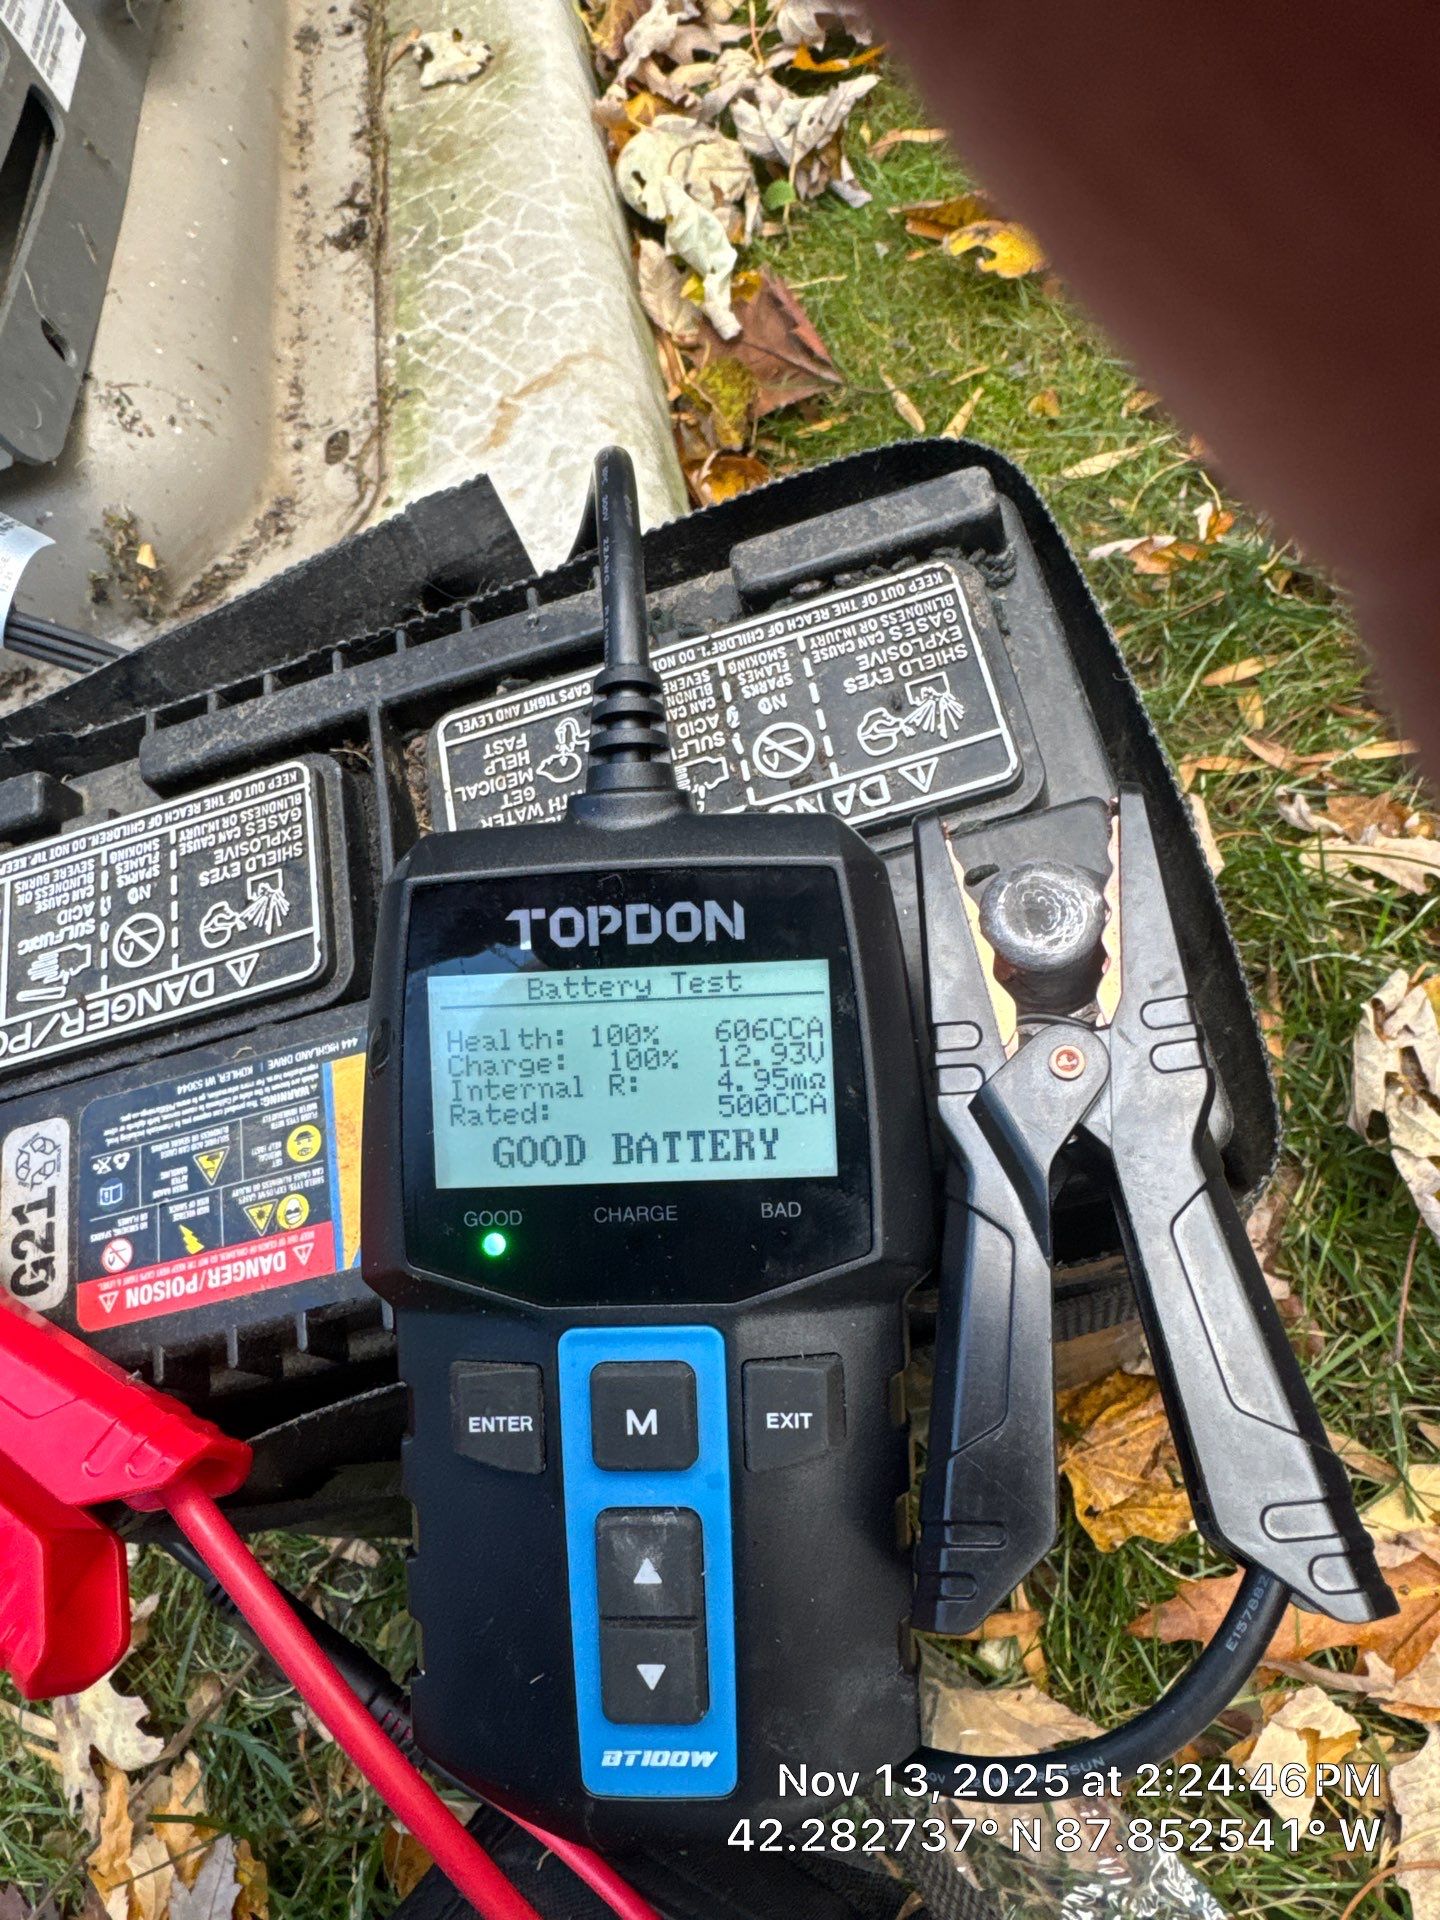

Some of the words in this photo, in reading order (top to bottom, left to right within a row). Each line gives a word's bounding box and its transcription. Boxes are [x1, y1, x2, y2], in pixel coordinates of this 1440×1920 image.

[877, 582, 906, 602] OUT
[906, 570, 944, 593] KEEP
[831, 597, 859, 617] THE
[858, 591, 879, 609] OF
[878, 592, 955, 628] BLINDNESS
[765, 620, 785, 638] OF
[785, 606, 830, 632] REACH
[857, 616, 879, 635] OR
[886, 606, 958, 643] GASES
[806, 623, 857, 650] INJURY
[854, 623, 964, 672] EXPLOSIVE
[855, 629, 886, 650] CAN
[677, 647, 695, 665] DO
[726, 645, 787, 675] SMOKING
[809, 638, 857, 664] CAUSE
[896, 642, 969, 678] SHIELD
[661, 667, 710, 695] SEVERE
[736, 658, 790, 687] FLAMES
[740, 671, 793, 699] SPARKS
[841, 665, 895, 695] EYES
[520, 691, 557, 715] TIGHT
[559, 681, 591, 703] CAPS
[756, 690, 788, 717] NO
[494, 702, 521, 722] AND
[689, 695, 716, 715] CAN
[455, 711, 493, 735] LEVEL
[675, 711, 720, 740] ACID
[480, 731, 527, 759] FAST
[483, 748, 530, 777] HELP
[243, 780, 264, 798] OUT
[267, 769, 296, 790] KEEP
[454, 765, 534, 804] MEDICAL
[204, 793, 224, 811] THE
[226, 787, 241, 804] OF
[239, 792, 302, 823] BLINDNESS
[498, 784, 535, 810] GET
[146, 812, 161, 829] OF
[163, 800, 201, 825] REACH
[221, 812, 237, 829] OR
[244, 805, 301, 837] GASES
[177, 818, 220, 843] INJURY
[217, 824, 240, 844] CAN
[47, 841, 69, 861] NOT
[71, 836, 85, 853] DO
[109, 836, 159, 864] SMOKING
[178, 832, 215, 856] CAUSE
[213, 822, 302, 865] EXPLOSIVE
[244, 839, 302, 873] SHIELD
[51, 856, 94, 882] SEVERE
[115, 849, 159, 876] FLAMES
[198, 859, 241, 887] EYES
[13, 871, 49, 894] BURNS
[34, 869, 94, 901] BLINDNESS
[117, 863, 160, 888] SPARKS
[16, 889, 32, 906] OR
[33, 891, 69, 914] CAUSE
[71, 883, 93, 902] CAN
[128, 882, 151, 906] NO
[57, 899, 94, 926] ACID
[504, 900, 746, 950] TOPDON
[16, 916, 95, 956] SULFURIC
[527, 977, 651, 1002] Battery
[671, 970, 741, 994] Test
[342, 1036, 358, 1050] 444
[446, 1029, 565, 1053] Health:
[591, 1024, 660, 1048] 100%
[714, 1017, 824, 1042] 606CCA
[268, 1053, 294, 1070] DRIVE
[295, 1041, 339, 1063] HIGHLAND
[447, 1054, 567, 1078] Charge:
[609, 1048, 679, 1072] 100%
[718, 1042, 824, 1068] 12.93V
[176, 1077, 203, 1095] 53044
[204, 1074, 215, 1087] WI
[450, 1077, 584, 1102] Internal
[609, 1074, 639, 1097] R:
[450, 1102, 549, 1127] Rated:
[718, 1094, 827, 1118] 500CCA
[493, 1134, 586, 1169] GOOD
[612, 1128, 779, 1165] BATTERY
[463, 1210, 523, 1228] GOOD
[593, 1205, 679, 1224] CHARGE
[760, 1201, 801, 1220] BAD
[10, 1186, 56, 1297] G21
[125, 1248, 286, 1309] DANGER/POISON
[468, 1415, 533, 1434] ENTER
[625, 1409, 658, 1435] M
[766, 1412, 813, 1430] EXIT
[602, 1750, 719, 1768] BT100W
